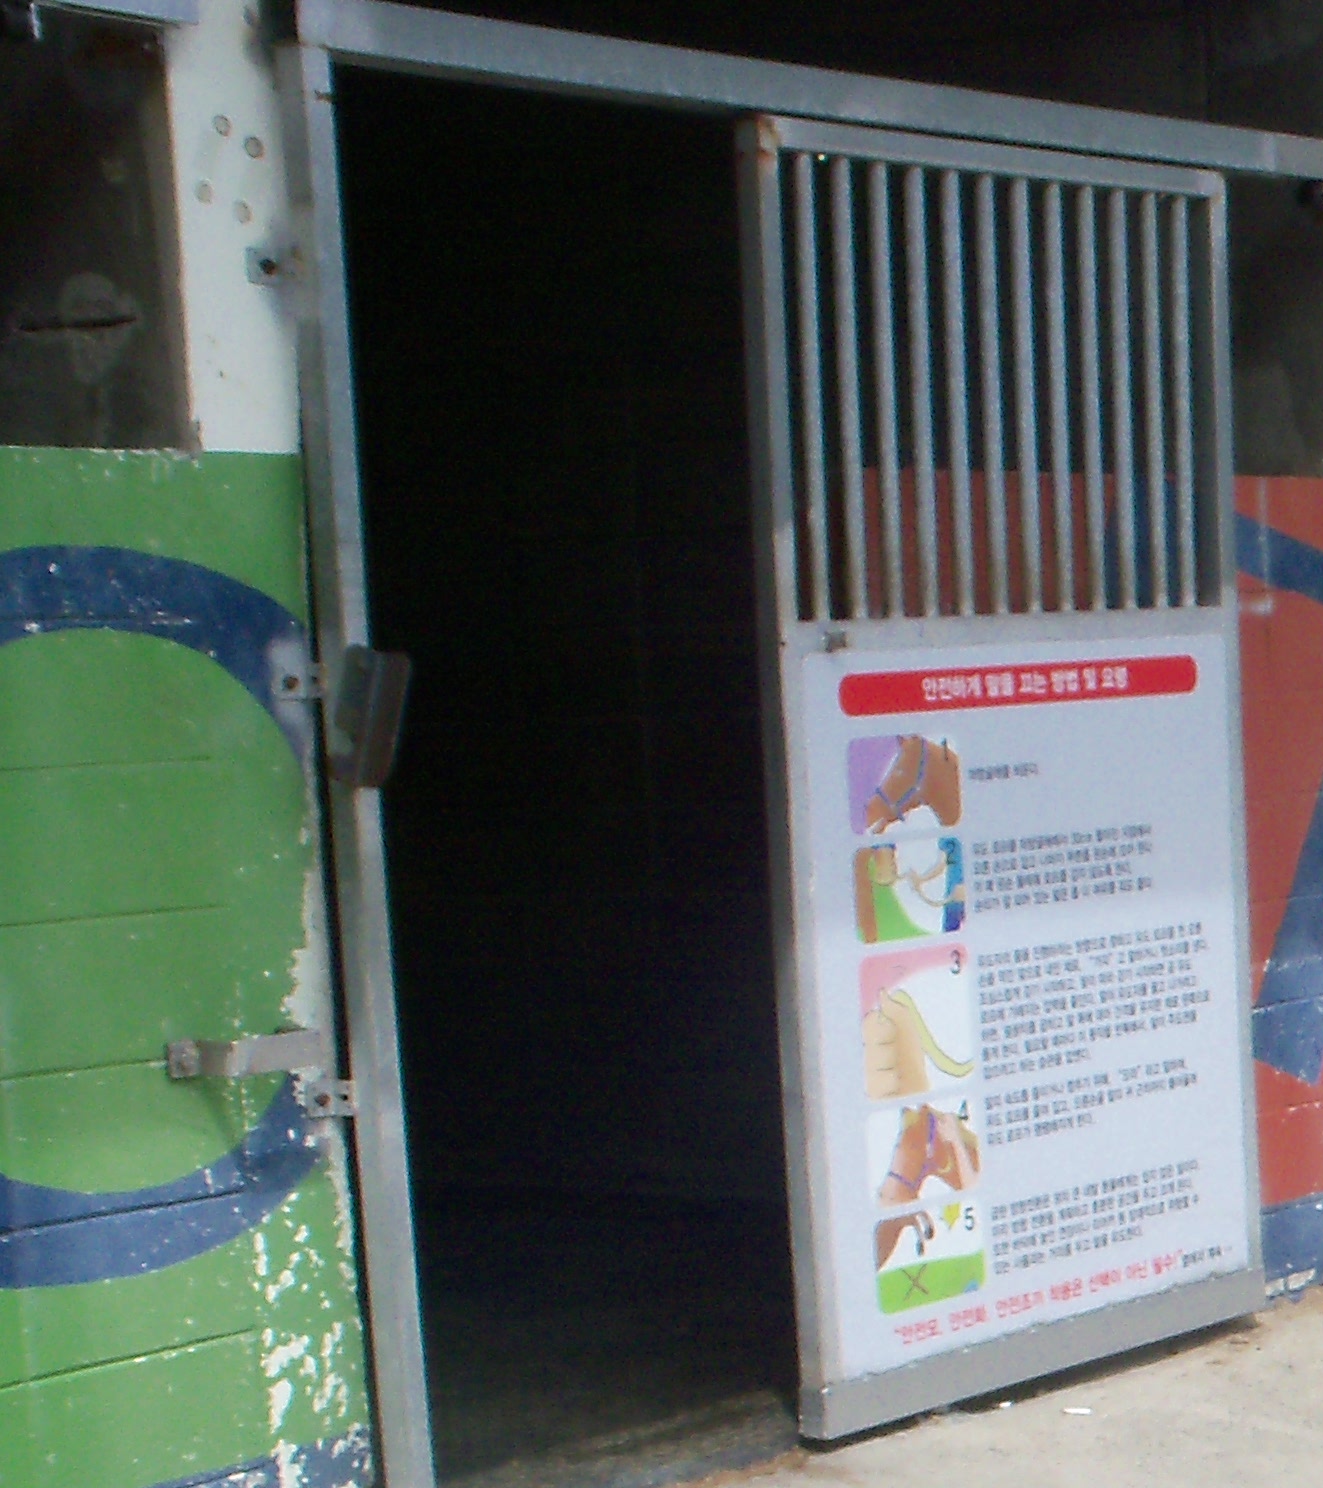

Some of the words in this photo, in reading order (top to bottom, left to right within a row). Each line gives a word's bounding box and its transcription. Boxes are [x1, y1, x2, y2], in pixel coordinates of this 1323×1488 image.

[921, 674, 982, 701] 안전하게
[950, 949, 960, 974] 3
[965, 1206, 975, 1231] 5
